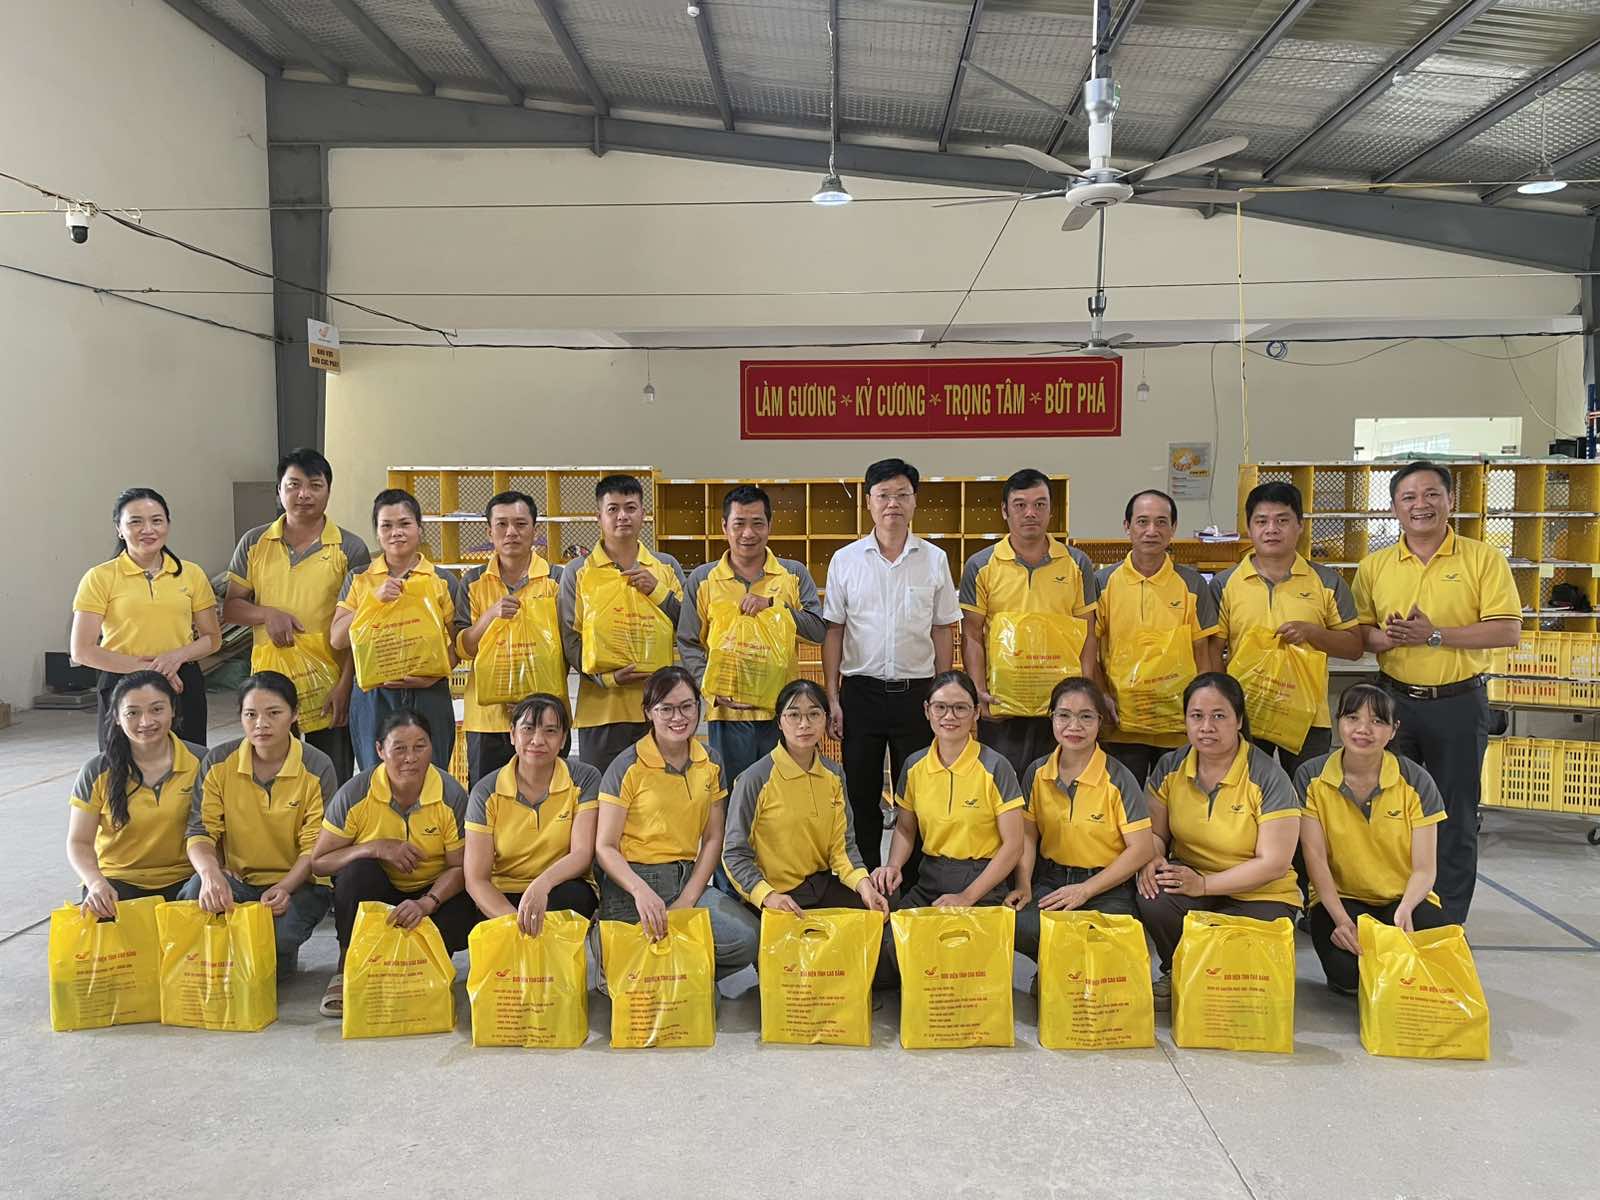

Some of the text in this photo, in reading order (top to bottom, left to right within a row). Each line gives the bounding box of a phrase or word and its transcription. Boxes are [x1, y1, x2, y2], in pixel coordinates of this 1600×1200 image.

[755, 376, 1106, 421] LÀM GƯƠNG KỶ CƯƠNG TRỌNG TÂM BỨT PHÁ
